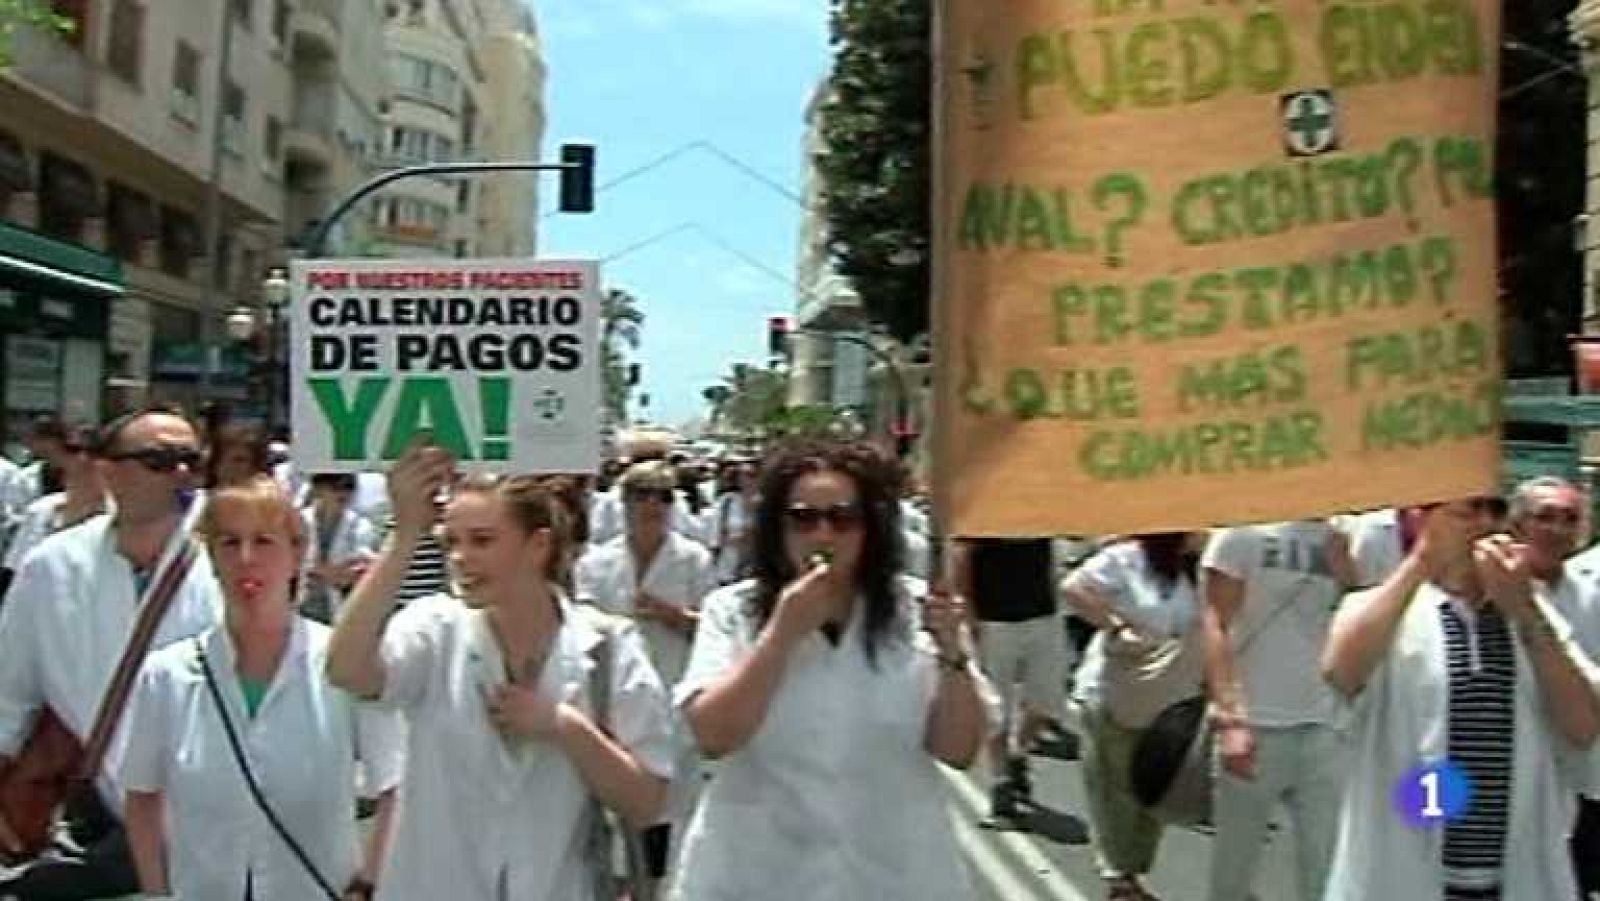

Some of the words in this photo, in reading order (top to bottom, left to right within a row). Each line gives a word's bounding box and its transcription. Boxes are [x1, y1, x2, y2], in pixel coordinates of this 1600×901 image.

[1017, 11, 1292, 118] PUEDO
[356, 271, 465, 290] NUESTROS
[469, 271, 584, 290] PACIENTES
[308, 297, 582, 326] CALENDARIO
[310, 334, 380, 370] DE
[396, 334, 583, 371] PAGOS
[306, 376, 512, 460] YA!
[1076, 410, 1330, 482] COMPRAR
